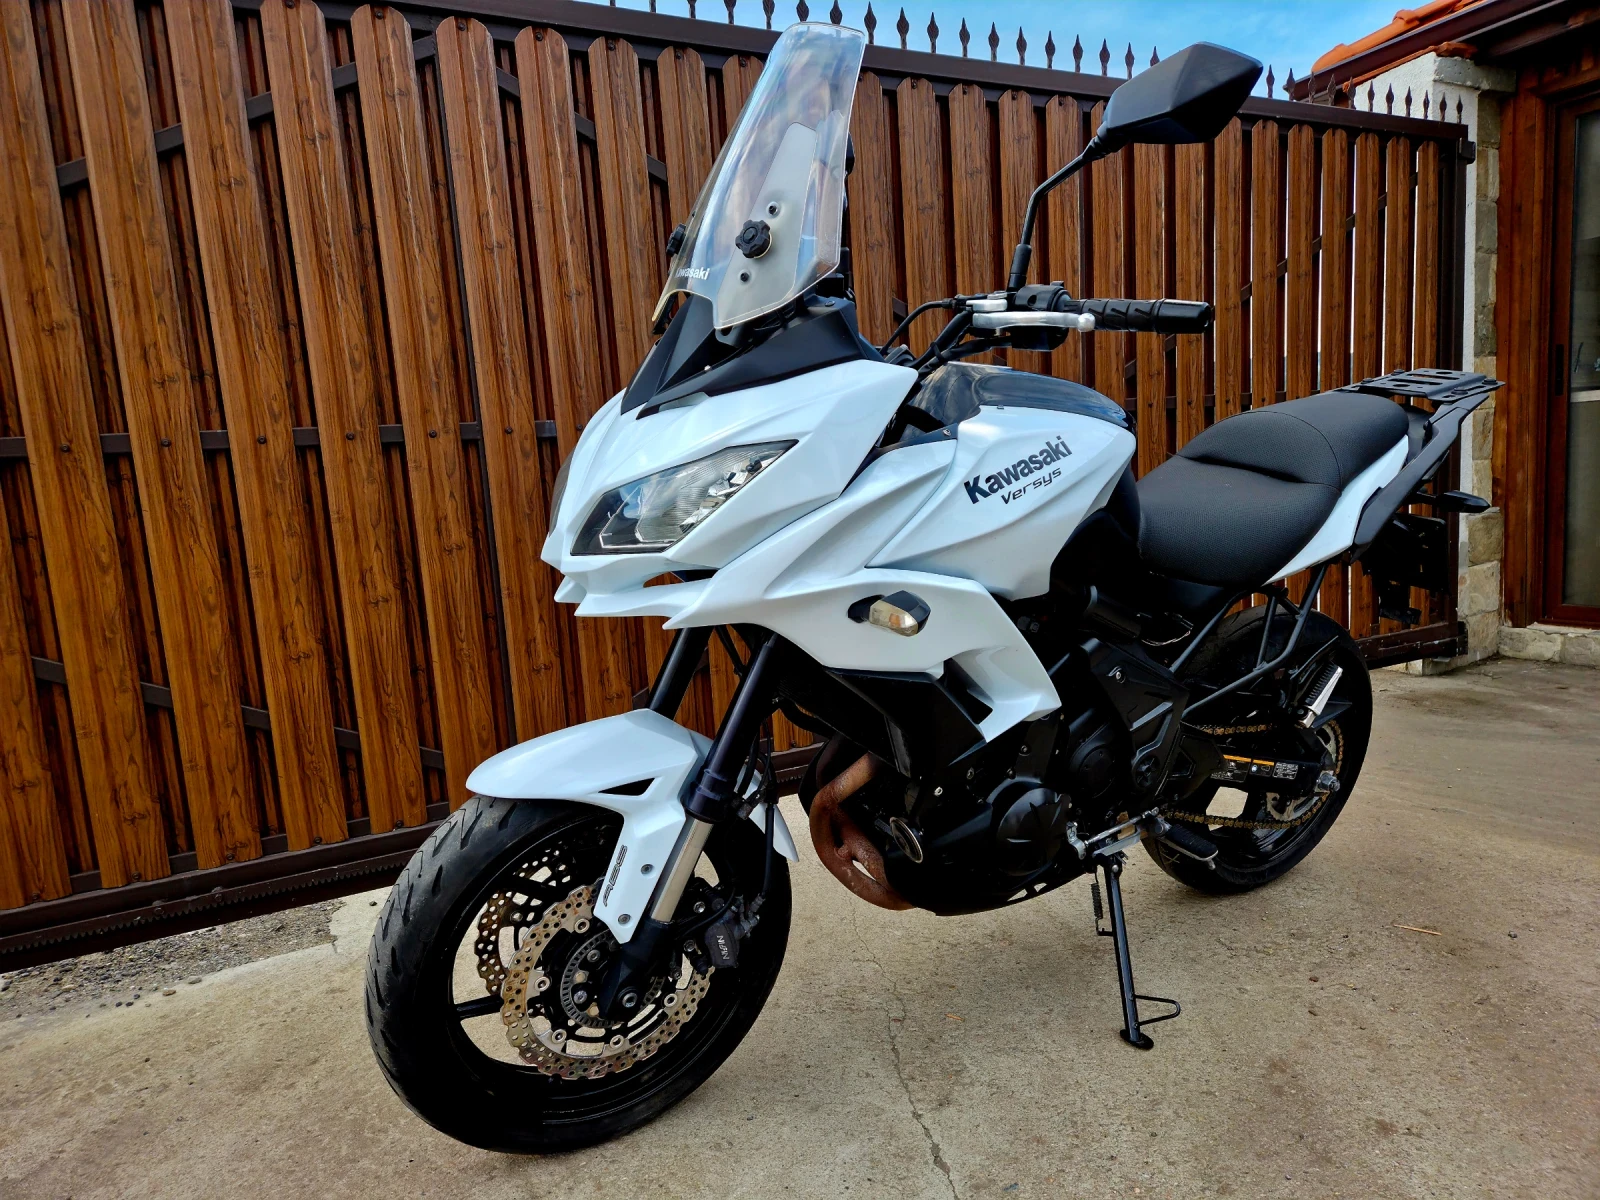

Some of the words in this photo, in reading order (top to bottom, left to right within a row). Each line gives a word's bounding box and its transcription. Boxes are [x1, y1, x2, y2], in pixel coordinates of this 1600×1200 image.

[963, 435, 1073, 505] Kawasaki
[1001, 467, 1062, 505] Versys
[602, 844, 628, 908] ABS
